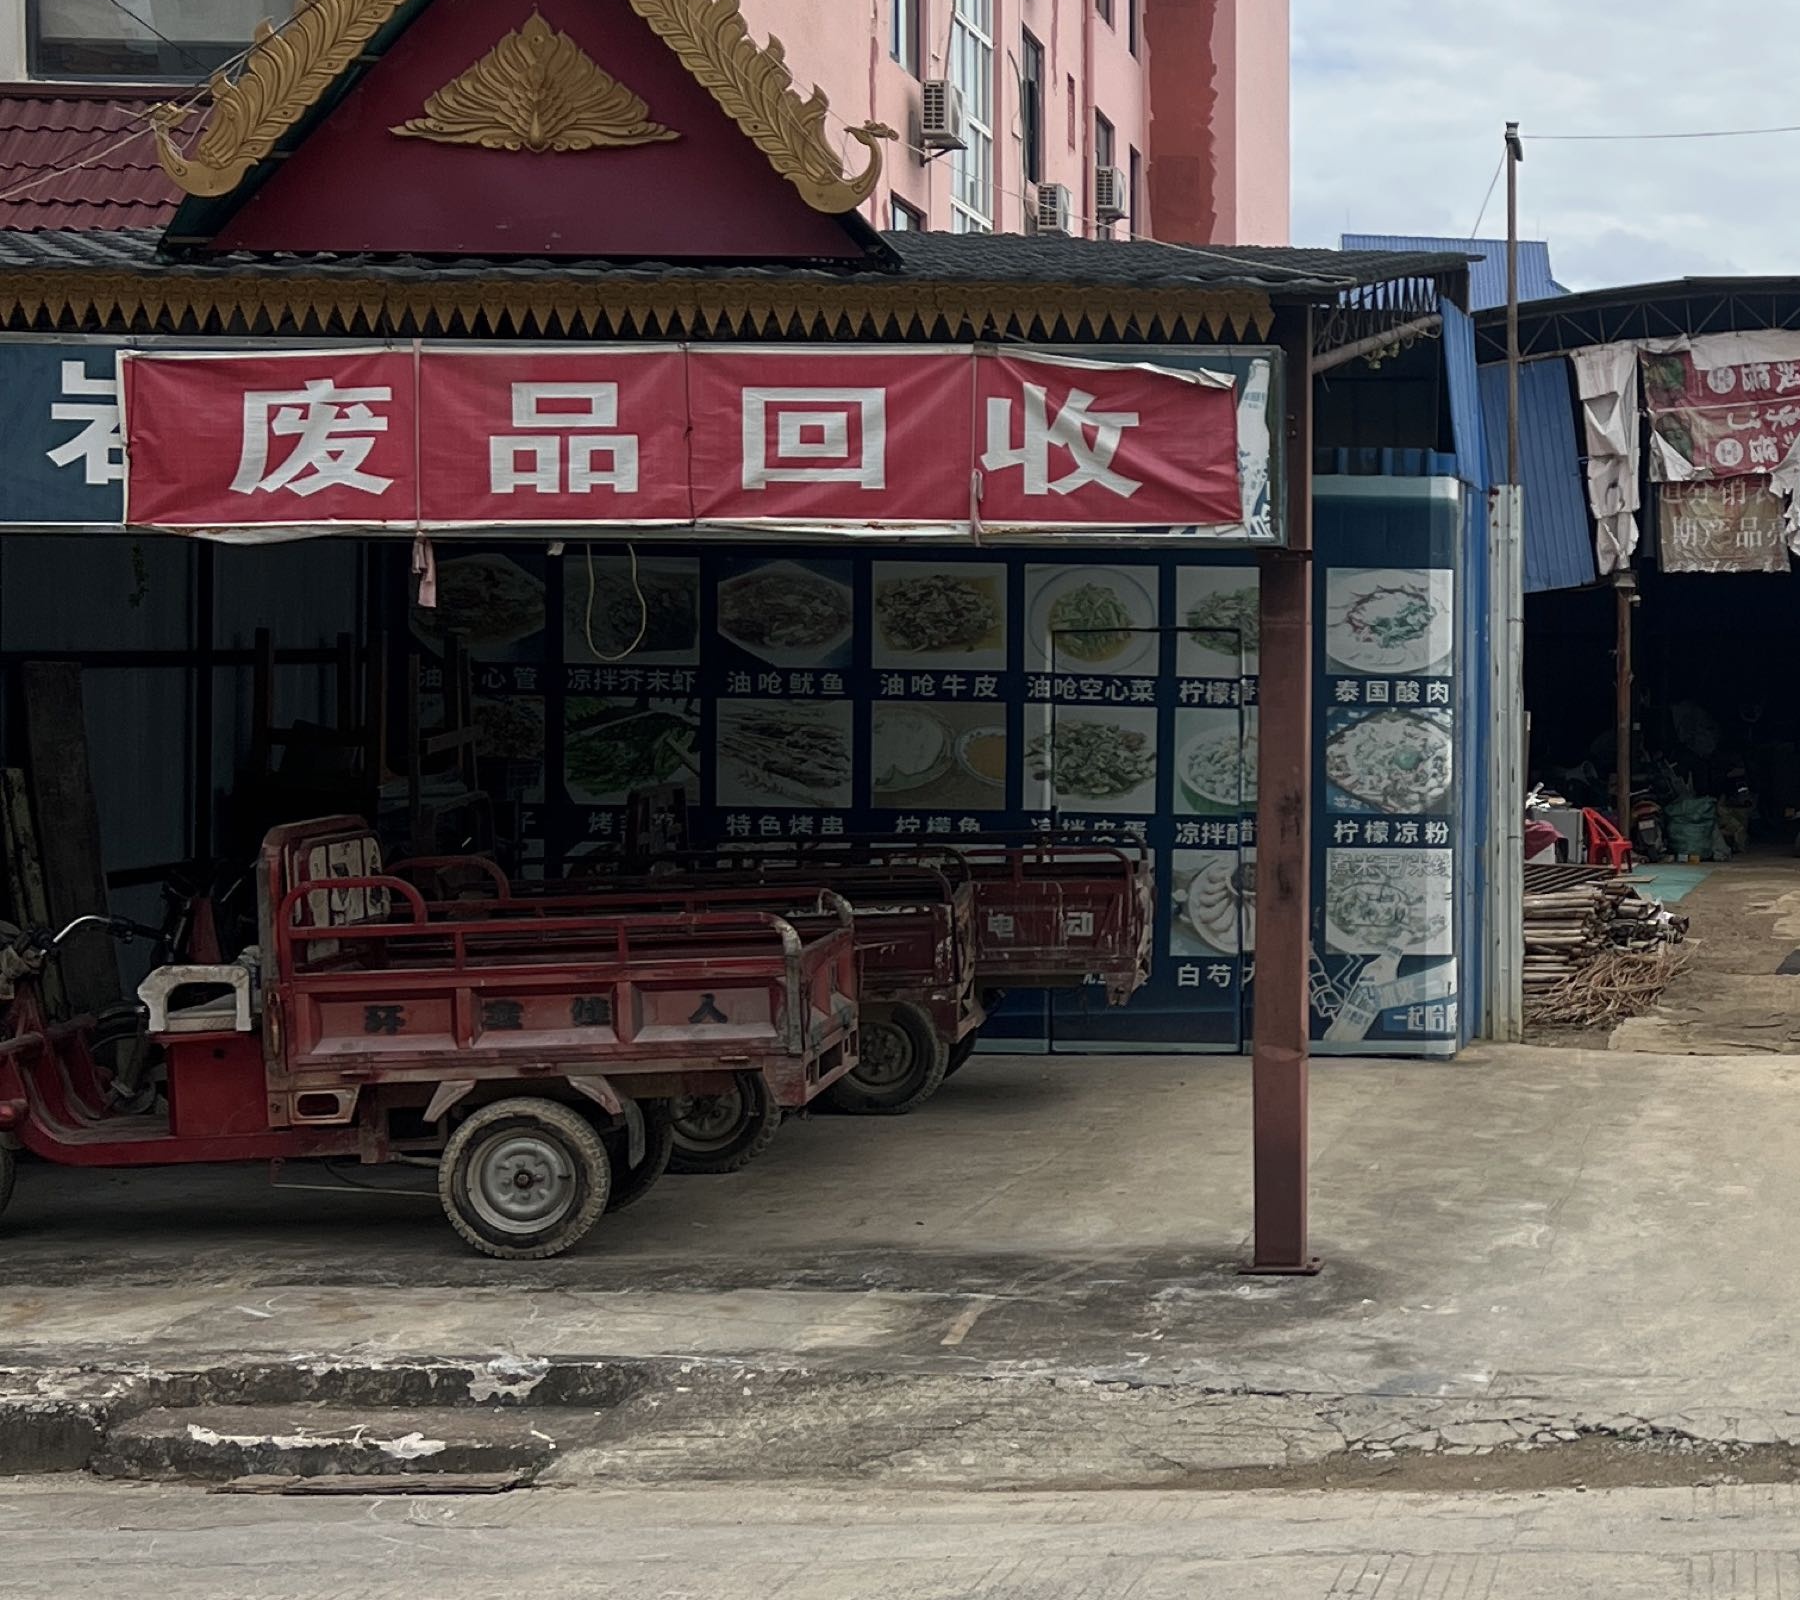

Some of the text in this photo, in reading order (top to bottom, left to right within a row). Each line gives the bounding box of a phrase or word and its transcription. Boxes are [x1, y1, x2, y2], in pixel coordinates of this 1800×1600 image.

[229, 377, 1142, 498] 废品回收
[420, 667, 540, 691] 油心管
[566, 667, 697, 693] 凉拌芥末虾
[725, 670, 846, 695] 油呛鱿鱼
[879, 673, 1000, 698] 油呛牛皮
[1026, 676, 1156, 703] 油呛空心菜
[1334, 679, 1450, 705] 泰国酸肉
[725, 812, 846, 837] 特色烤串
[1174, 818, 1257, 845] 凉拌醋
[1333, 820, 1450, 845] 柠檬凉粉
[987, 910, 1094, 938] 电动
